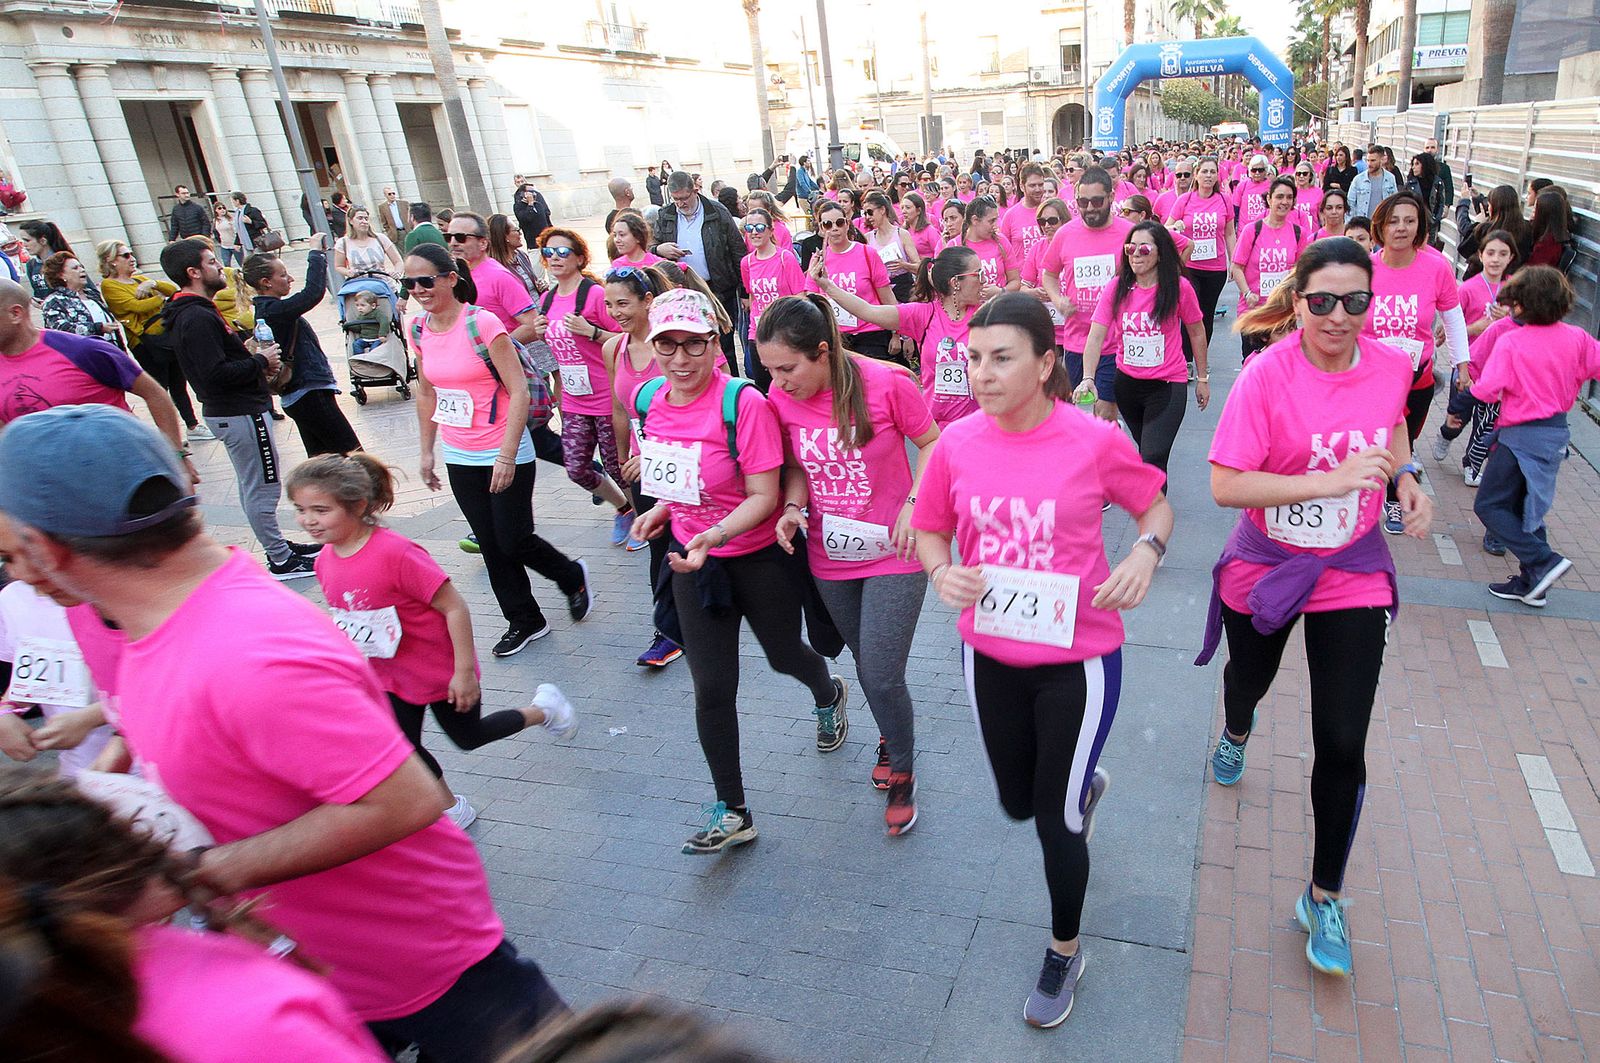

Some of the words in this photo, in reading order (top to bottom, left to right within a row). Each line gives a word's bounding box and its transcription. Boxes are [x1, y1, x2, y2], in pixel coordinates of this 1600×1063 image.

[250, 38, 360, 56] AYNTAMIENTO
[1106, 60, 1136, 93] DEPORTES
[1184, 64, 1225, 74] HUELVA
[1247, 52, 1278, 84] DEPORTES
[1263, 132, 1289, 141] HUELVA
[1193, 211, 1218, 224] KM
[1192, 223, 1218, 232] POR
[1192, 231, 1217, 239] ELLAS
[1259, 247, 1288, 263] KM
[1076, 264, 1101, 278] 338
[1258, 262, 1288, 272] POR
[751, 276, 778, 293] KM
[1373, 294, 1418, 316] KM
[1373, 315, 1418, 332] POR
[1128, 344, 1145, 358] 82
[942, 368, 963, 383] 83
[258, 426, 267, 442] THE
[799, 425, 863, 461] KM
[262, 446, 275, 480] OUTSIDE
[643, 457, 678, 484] 768
[802, 460, 869, 481] POR
[811, 480, 872, 497] ELLAS
[969, 495, 1057, 543] KM
[1274, 503, 1323, 528] 183
[826, 531, 868, 551] 672
[979, 532, 1056, 572] POR
[979, 587, 1039, 619] 673
[15, 654, 65, 684] 821
